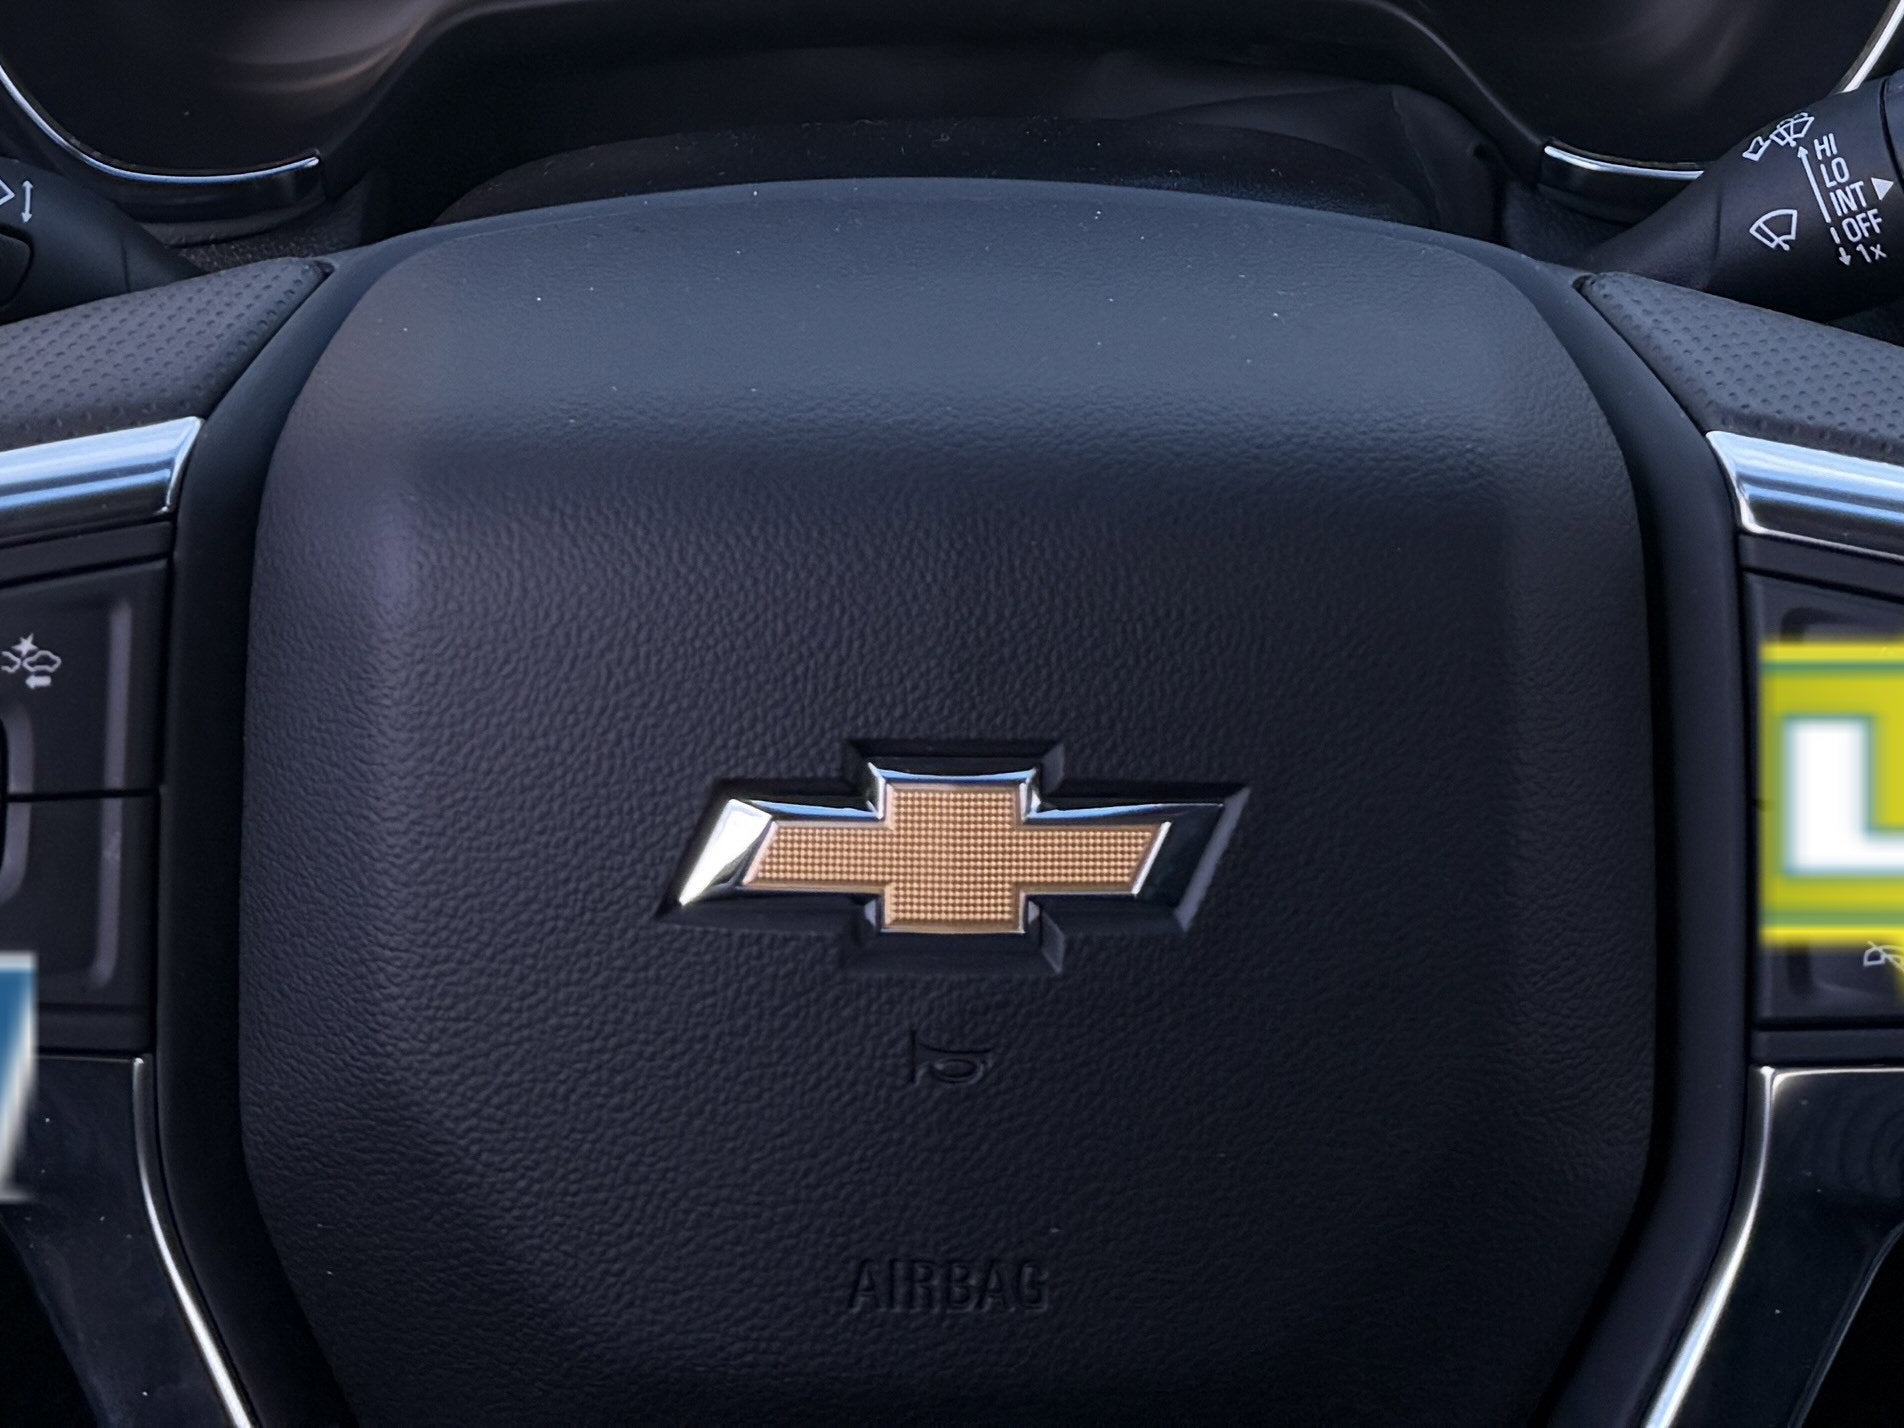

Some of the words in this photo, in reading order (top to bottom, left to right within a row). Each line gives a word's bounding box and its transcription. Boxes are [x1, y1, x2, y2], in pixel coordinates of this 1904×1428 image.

[1814, 133, 1838, 160] HI
[1820, 156, 1851, 189] LO
[1830, 181, 1867, 216] INT
[1842, 208, 1883, 243] OFF
[848, 1258, 1050, 1313] AIRBAG
